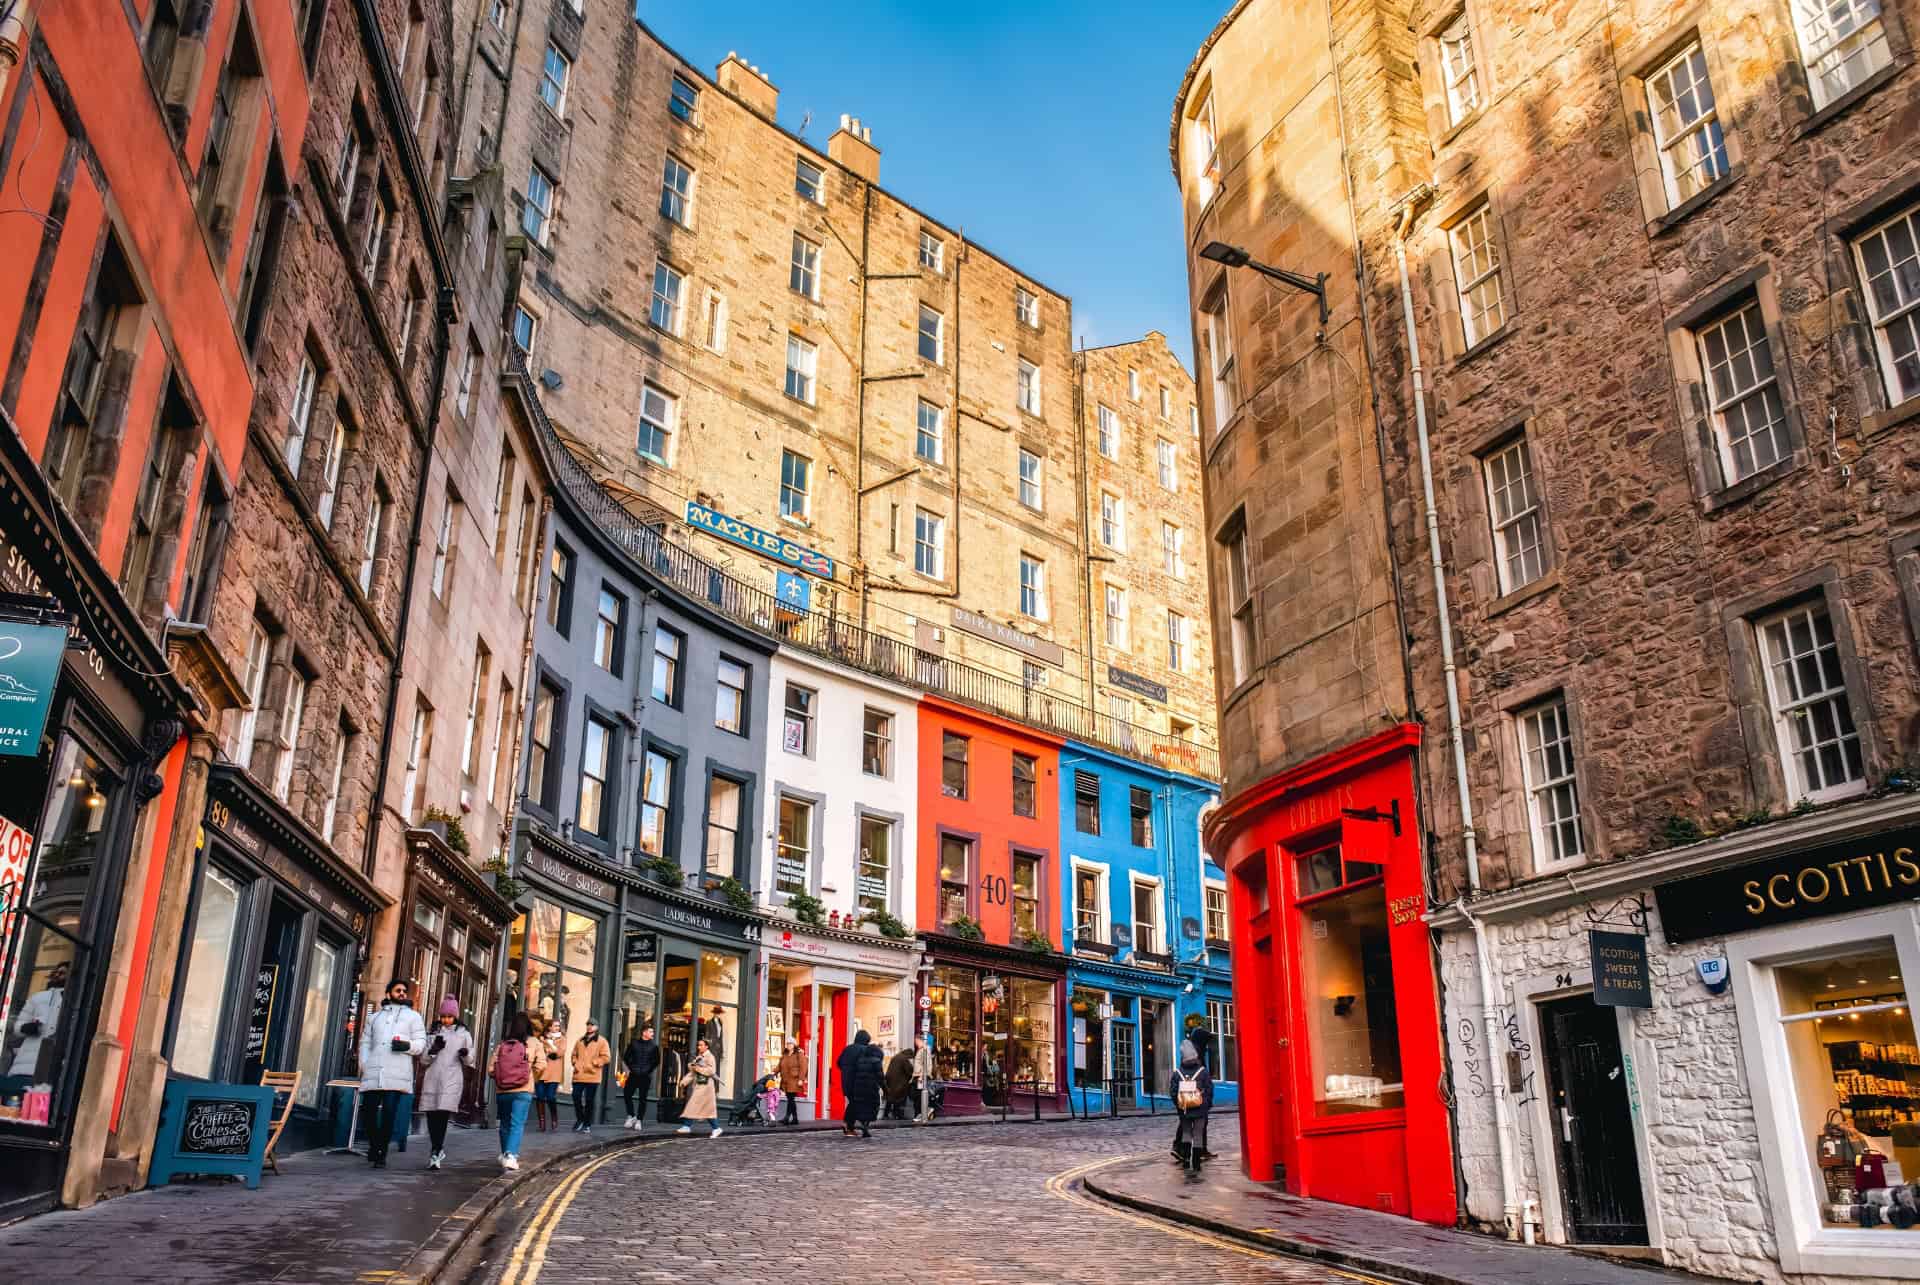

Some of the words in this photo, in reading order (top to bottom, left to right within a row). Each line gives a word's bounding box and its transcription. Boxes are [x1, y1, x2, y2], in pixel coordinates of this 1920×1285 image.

[689, 505, 801, 562] MAXIES
[211, 800, 229, 829] 89
[980, 874, 1007, 906] 40
[1743, 847, 1920, 915] SCOTTIS
[664, 906, 712, 929] LADIESWEAR
[1600, 947, 1640, 961] SCOTTISH
[1605, 962, 1639, 975] SWEETS
[1555, 972, 1573, 988] 94
[1612, 977, 1643, 991] TREATS
[921, 998, 930, 1006] 20
